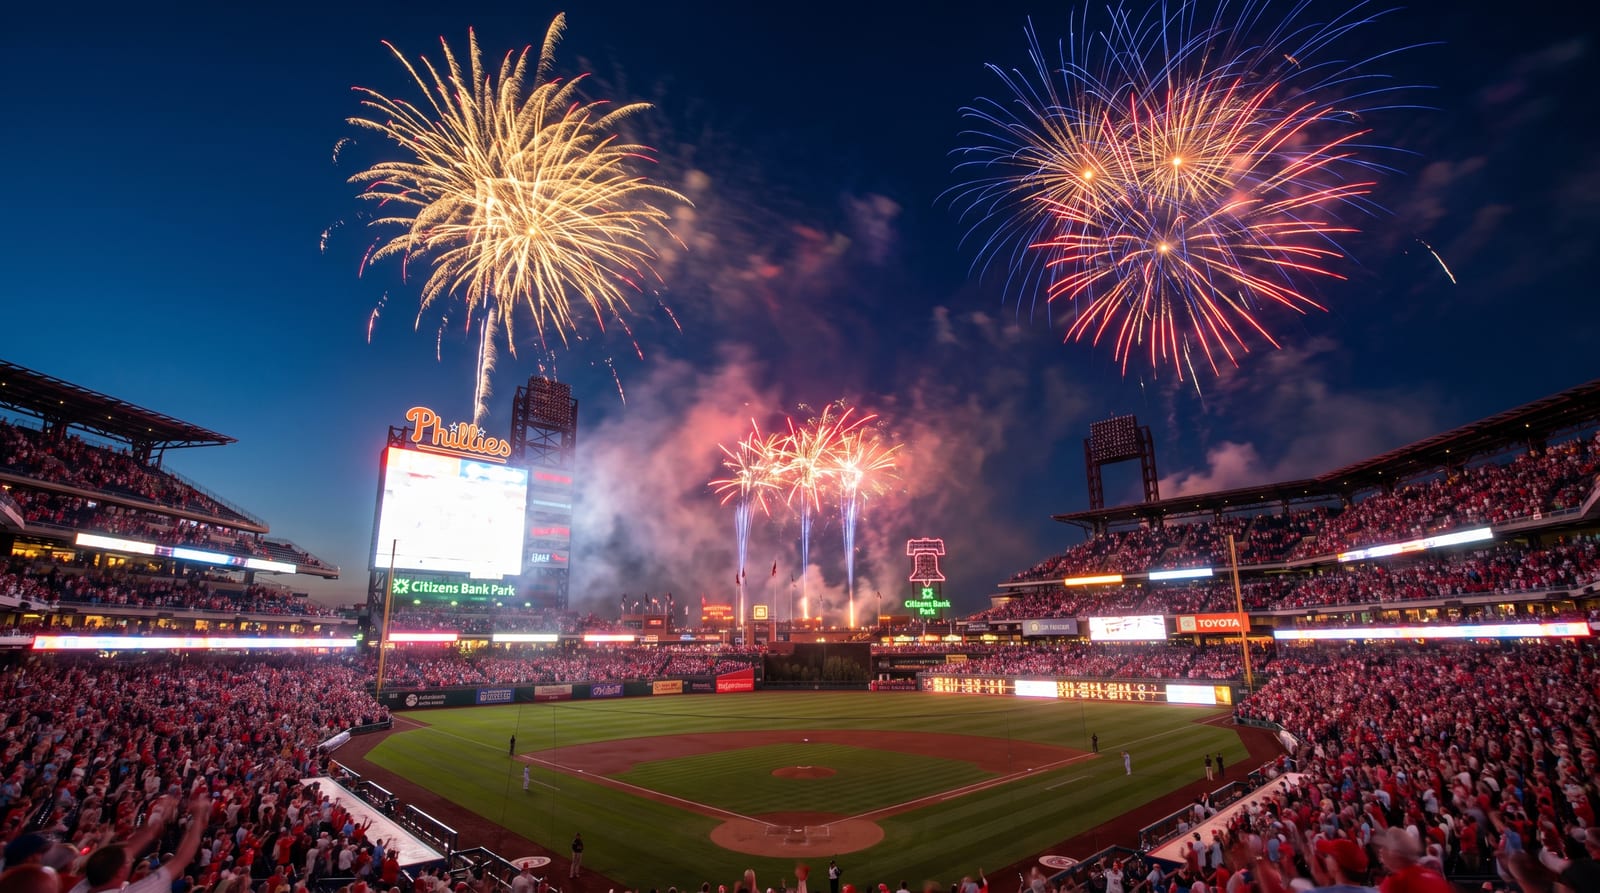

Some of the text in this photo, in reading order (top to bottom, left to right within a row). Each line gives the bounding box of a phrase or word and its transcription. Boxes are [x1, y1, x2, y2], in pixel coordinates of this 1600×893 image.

[406, 406, 511, 457] Phillies
[411, 580, 515, 596] Citizens Bank Park
[904, 600, 951, 608] Citizens Bank
[919, 607, 936, 615] Park
[1198, 618, 1240, 628] TOYOTA
